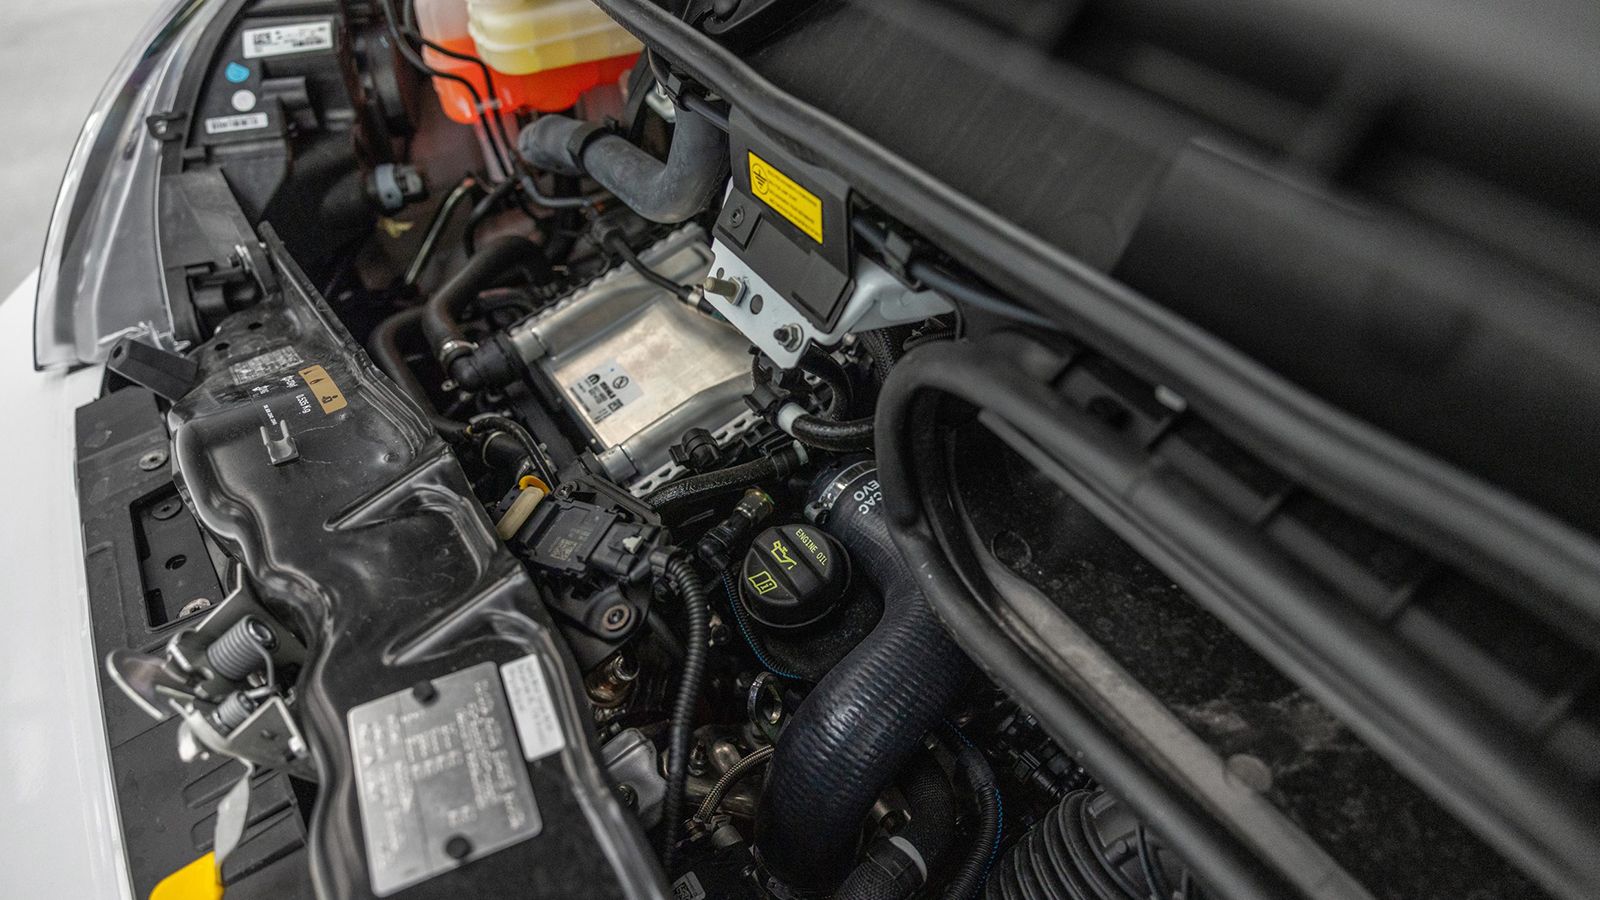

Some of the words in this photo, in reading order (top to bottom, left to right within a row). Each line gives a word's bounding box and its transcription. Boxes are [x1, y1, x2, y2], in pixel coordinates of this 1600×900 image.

[853, 480, 880, 501] EVO
[795, 528, 818, 554] ENGINE
[816, 552, 828, 566] OIL
